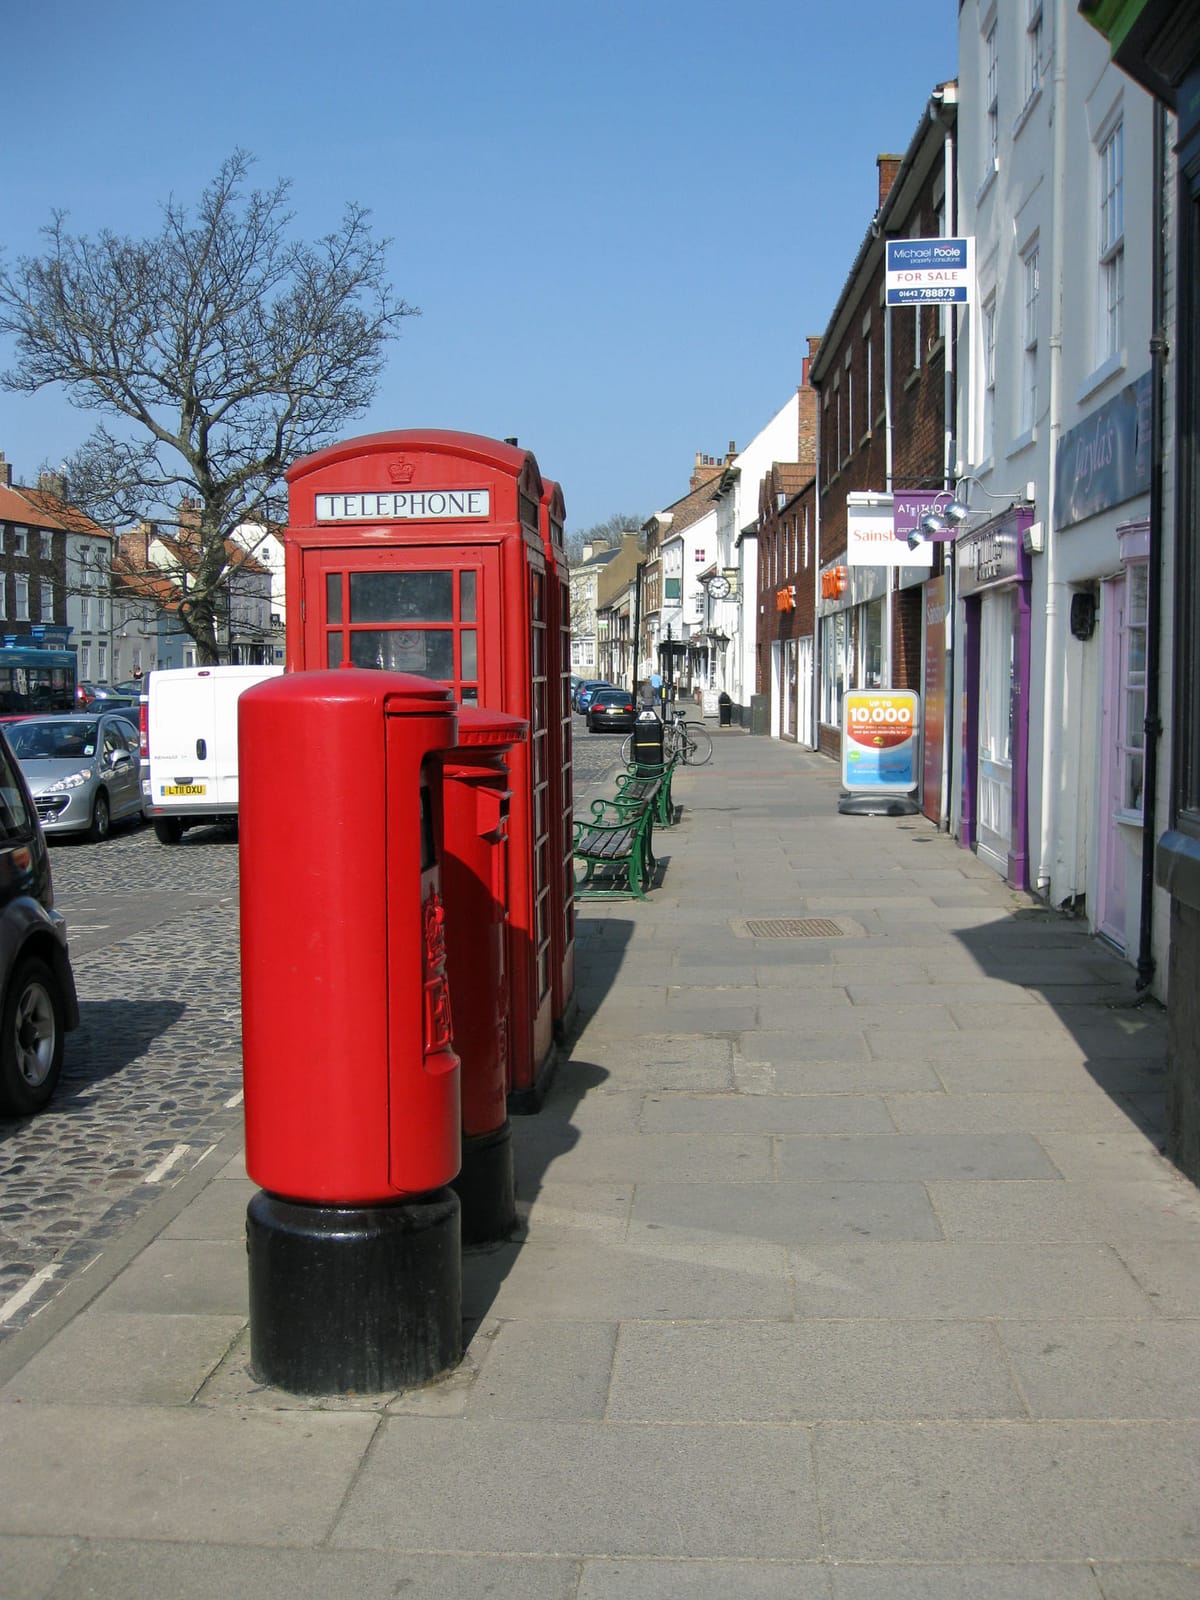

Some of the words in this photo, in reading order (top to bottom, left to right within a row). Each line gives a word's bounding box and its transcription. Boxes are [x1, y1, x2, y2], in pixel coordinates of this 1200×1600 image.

[894, 248, 931, 258] Michael
[934, 247, 960, 257] Poole
[897, 273, 922, 282] FOR
[927, 271, 958, 281] SALE
[920, 288, 955, 298] 788878
[325, 493, 481, 516] TELEPHONE
[850, 707, 910, 723] 10,000
